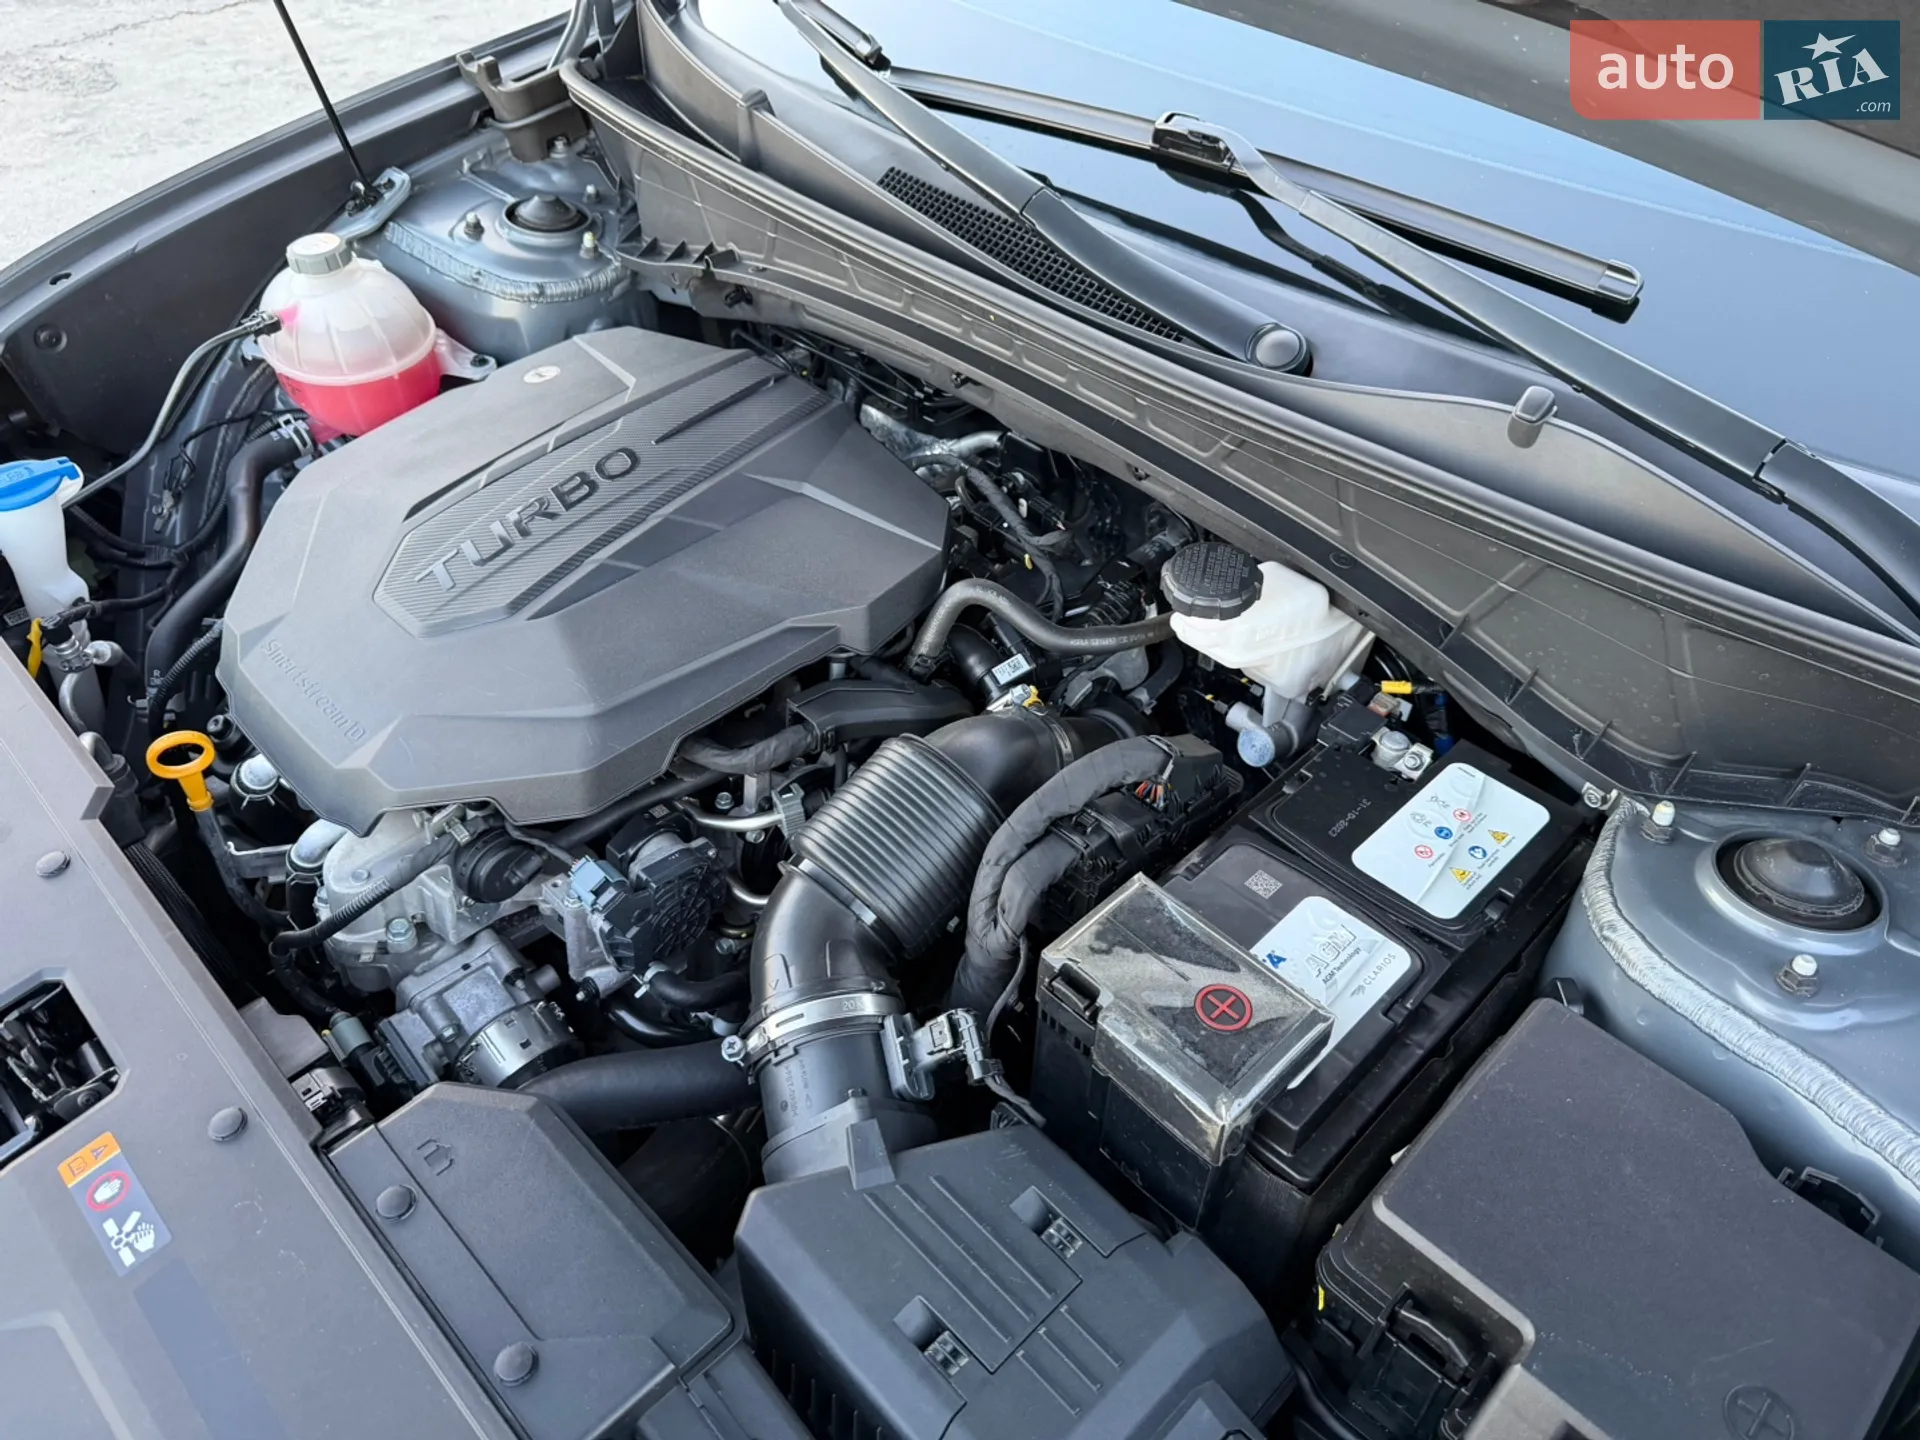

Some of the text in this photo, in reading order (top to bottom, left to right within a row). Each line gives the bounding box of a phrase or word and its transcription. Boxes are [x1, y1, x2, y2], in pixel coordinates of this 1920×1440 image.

[415, 447, 641, 592] TURBO
[1305, 924, 1357, 977] AGM
[1335, 946, 1362, 974] Technology
[1363, 953, 1396, 985] CLARIOS
